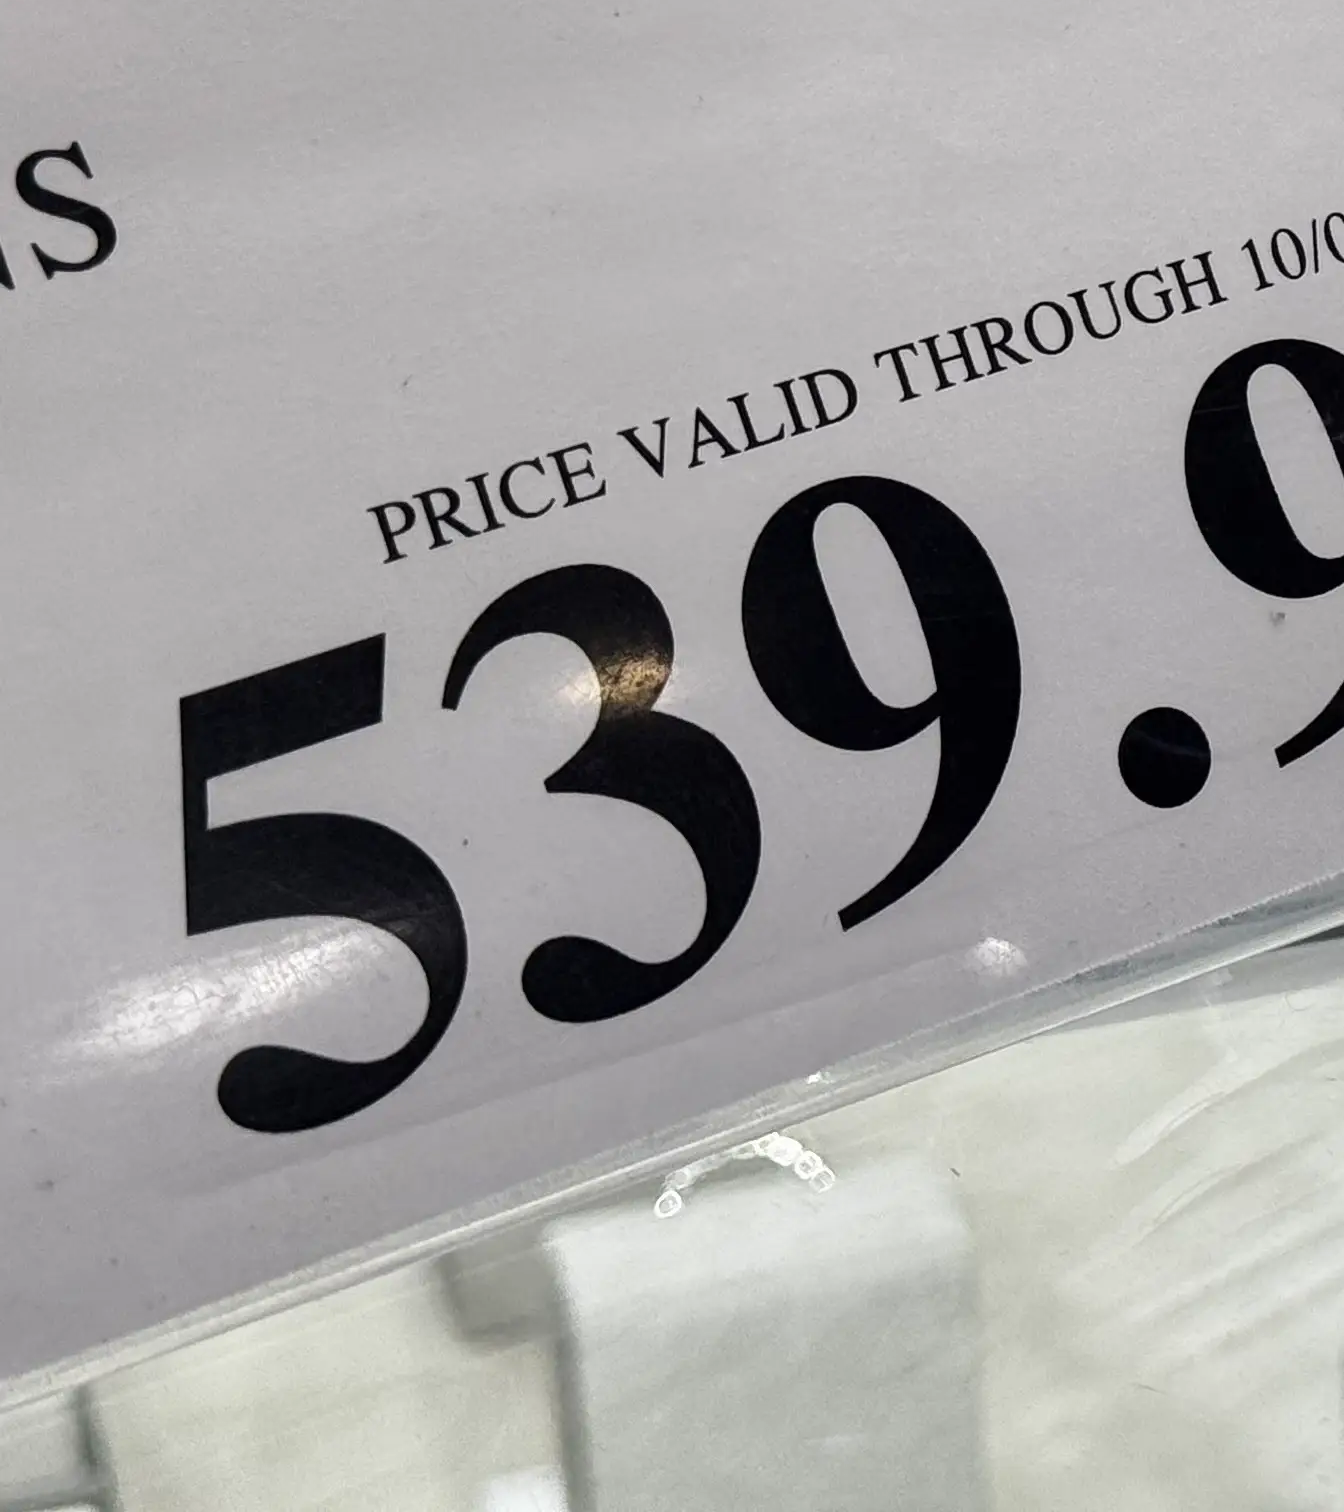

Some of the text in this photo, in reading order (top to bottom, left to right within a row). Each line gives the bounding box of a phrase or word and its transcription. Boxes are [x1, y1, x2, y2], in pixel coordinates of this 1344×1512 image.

[370, 440, 608, 564] PRICE
[617, 366, 860, 517] VALID
[873, 250, 1228, 405] THROUGH
